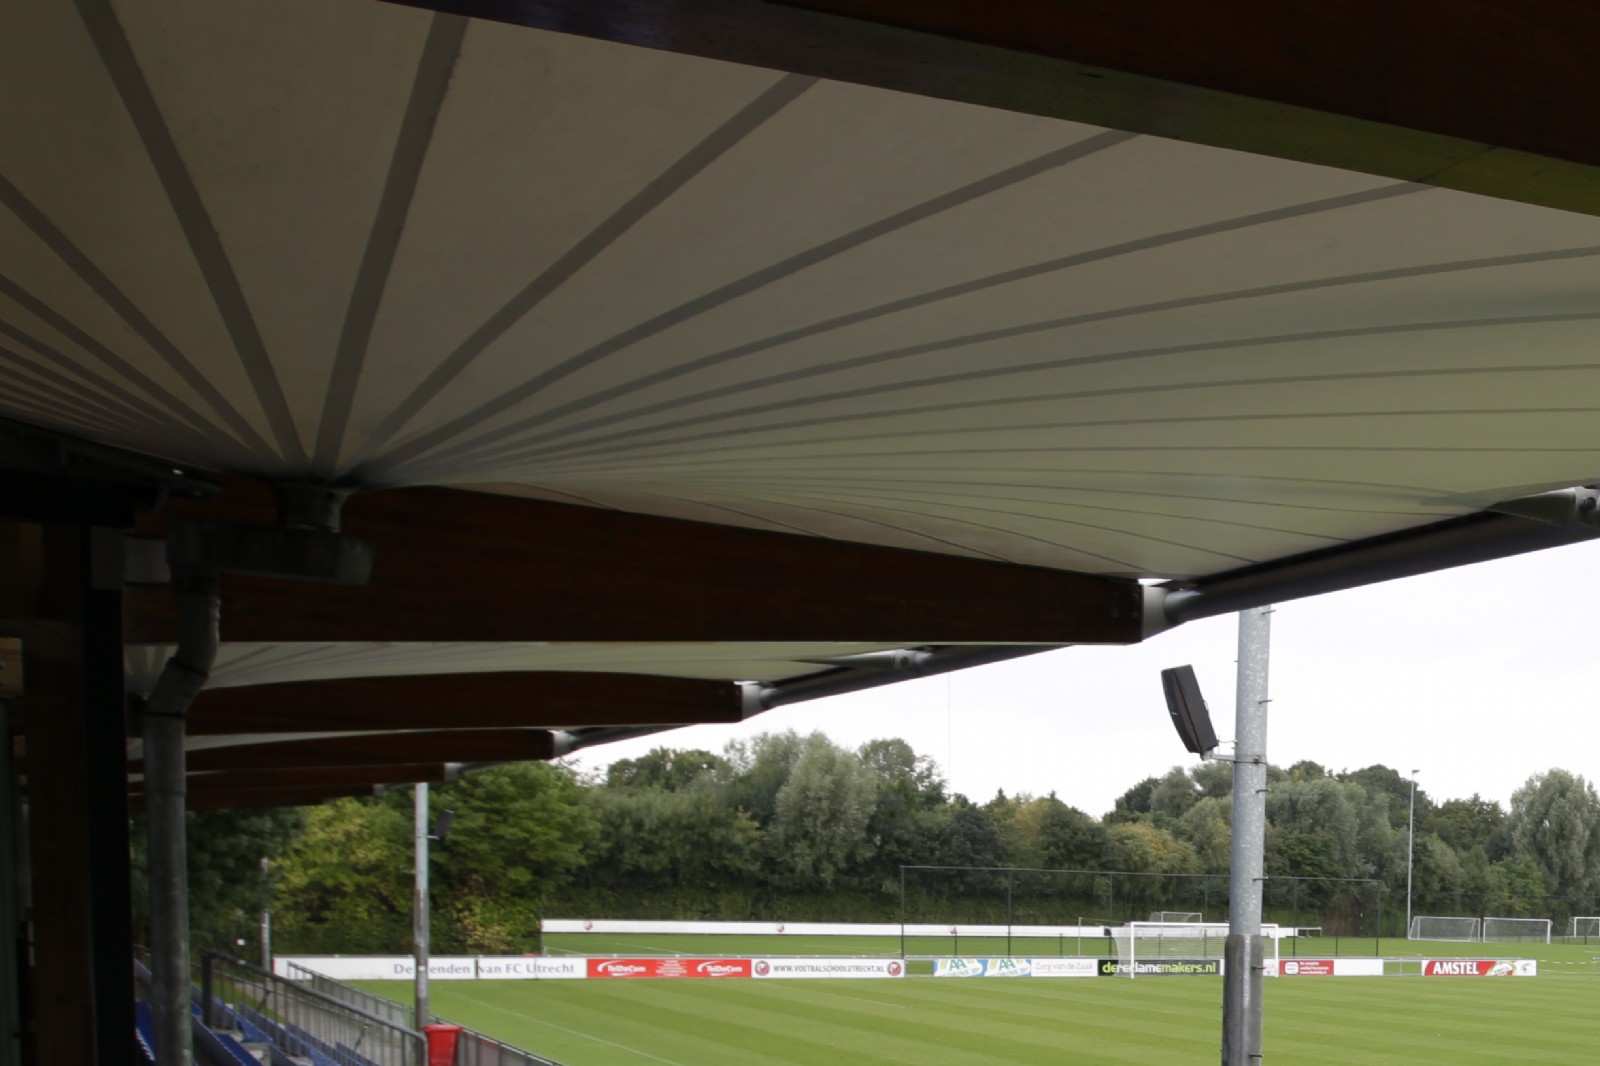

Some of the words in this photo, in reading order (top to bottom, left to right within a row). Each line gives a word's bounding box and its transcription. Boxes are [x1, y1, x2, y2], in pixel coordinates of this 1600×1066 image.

[393, 963, 413, 974] De
[505, 963, 522, 974] FC
[526, 962, 575, 974] Utrecht
[1433, 961, 1479, 975] AMSTEL
